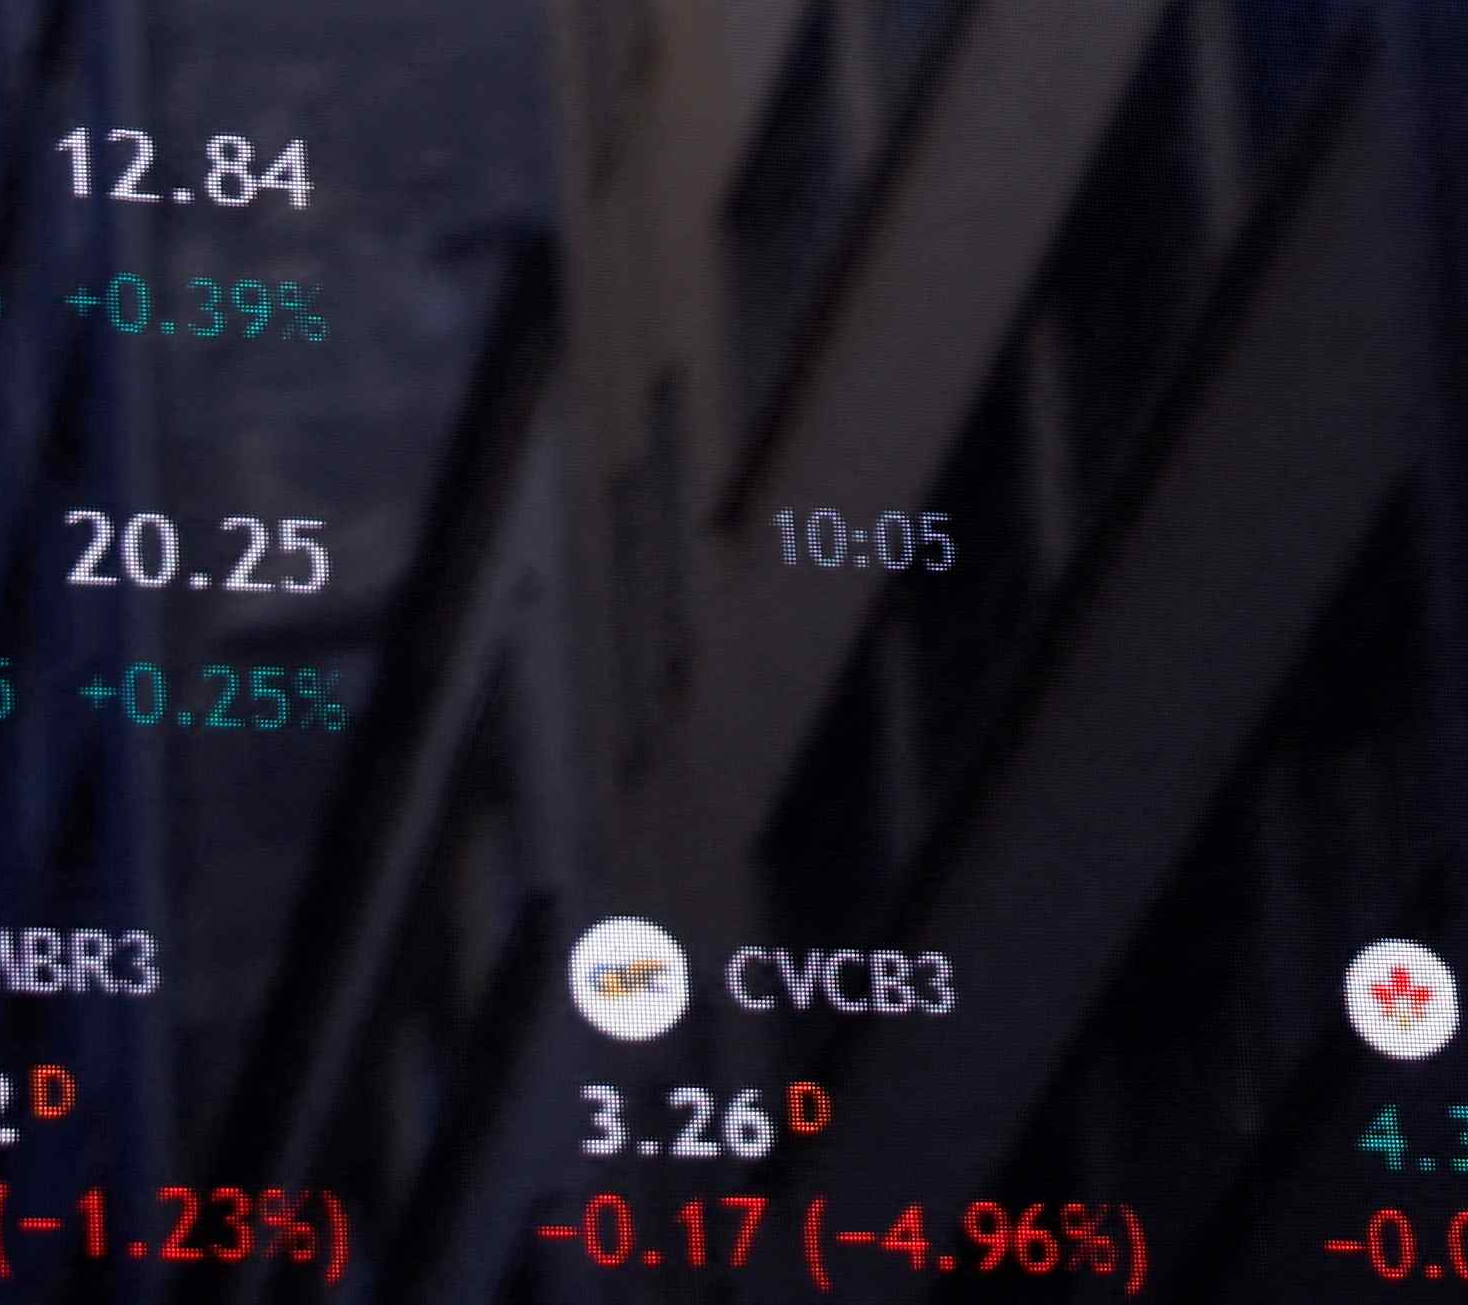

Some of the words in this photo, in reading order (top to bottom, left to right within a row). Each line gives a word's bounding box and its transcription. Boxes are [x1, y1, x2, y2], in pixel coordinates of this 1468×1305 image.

[54, 125, 315, 211] 12.84
[65, 272, 329, 341] +0.39%
[63, 508, 331, 595] 20.25
[771, 506, 957, 573] 10:05
[79, 661, 348, 732] +0.25%
[727, 945, 957, 1015] CVCB3
[30, 1064, 77, 1120] D
[580, 1081, 776, 1159] 3.26
[786, 1080, 831, 1134] D
[538, 1193, 770, 1269] -0.17
[804, 1193, 1148, 1295] (-4.96%)
